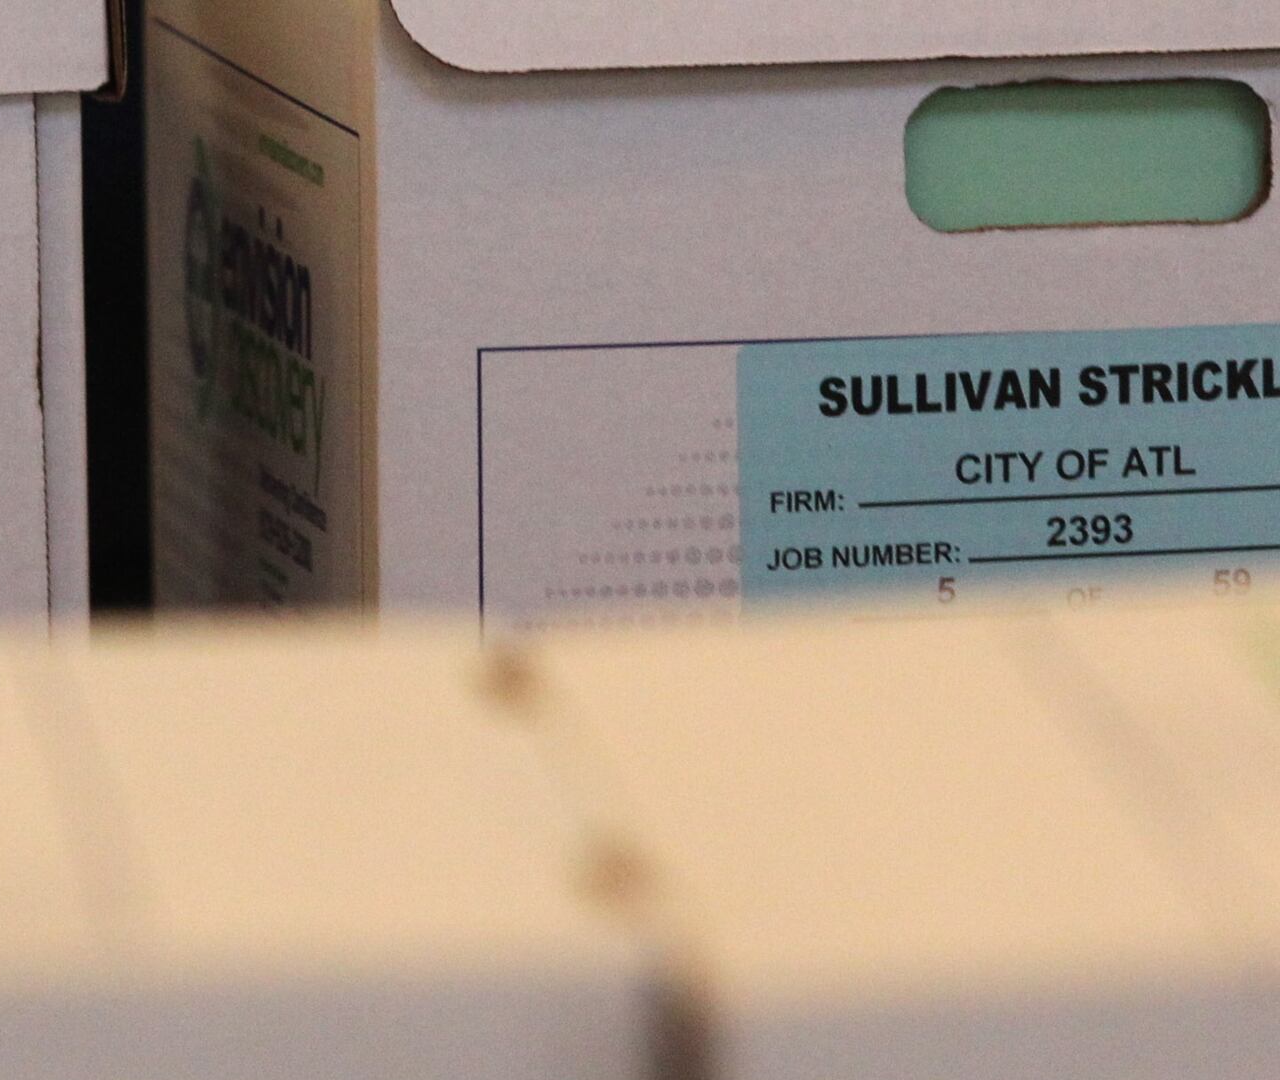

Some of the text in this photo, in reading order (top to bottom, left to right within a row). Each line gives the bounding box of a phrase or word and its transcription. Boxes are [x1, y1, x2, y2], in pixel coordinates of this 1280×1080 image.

[818, 357, 1280, 418] SULLIVAN STRICKL
[770, 444, 1197, 514] FIRM: CITY OF ATL
[766, 513, 1134, 571] JOB NUMBER: 2393
[938, 578, 957, 603] 5
[1213, 569, 1252, 596] 59
